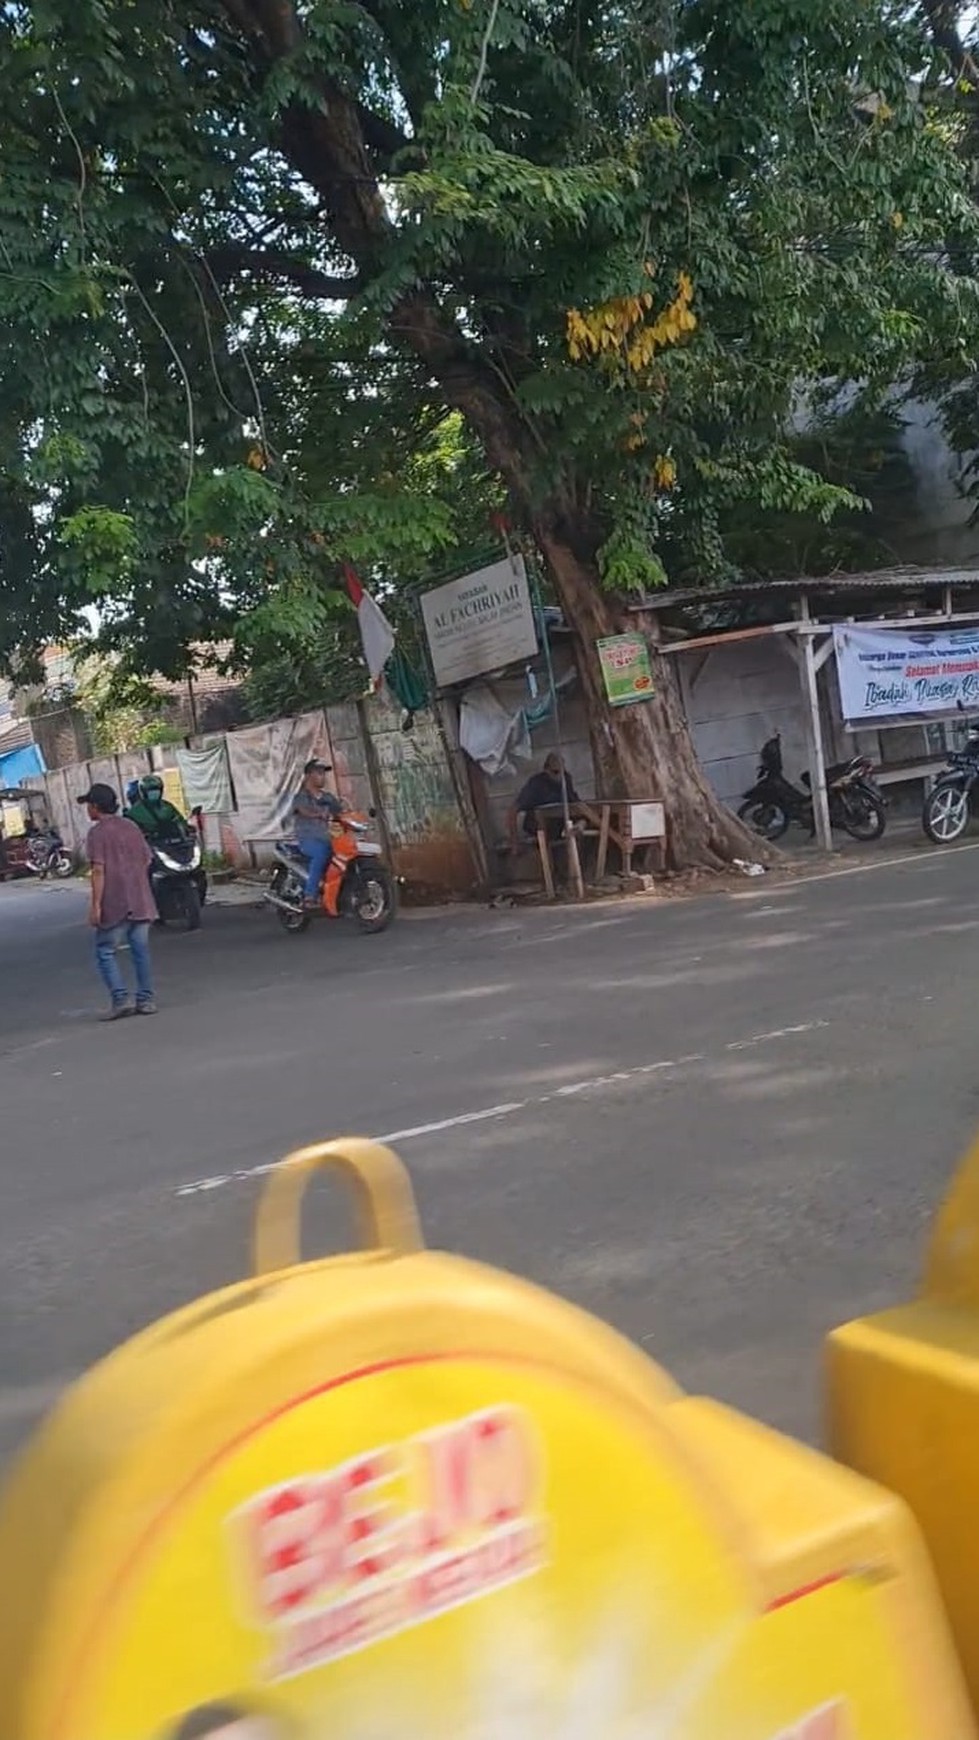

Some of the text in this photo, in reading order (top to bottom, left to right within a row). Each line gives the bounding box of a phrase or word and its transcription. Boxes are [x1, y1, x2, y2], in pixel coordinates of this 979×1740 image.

[434, 613, 448, 628] AL
[451, 584, 520, 622] FACHRIYAH
[905, 664, 940, 677] Selamat
[864, 681, 909, 706] Ibadah
[914, 678, 958, 702] Puasa
